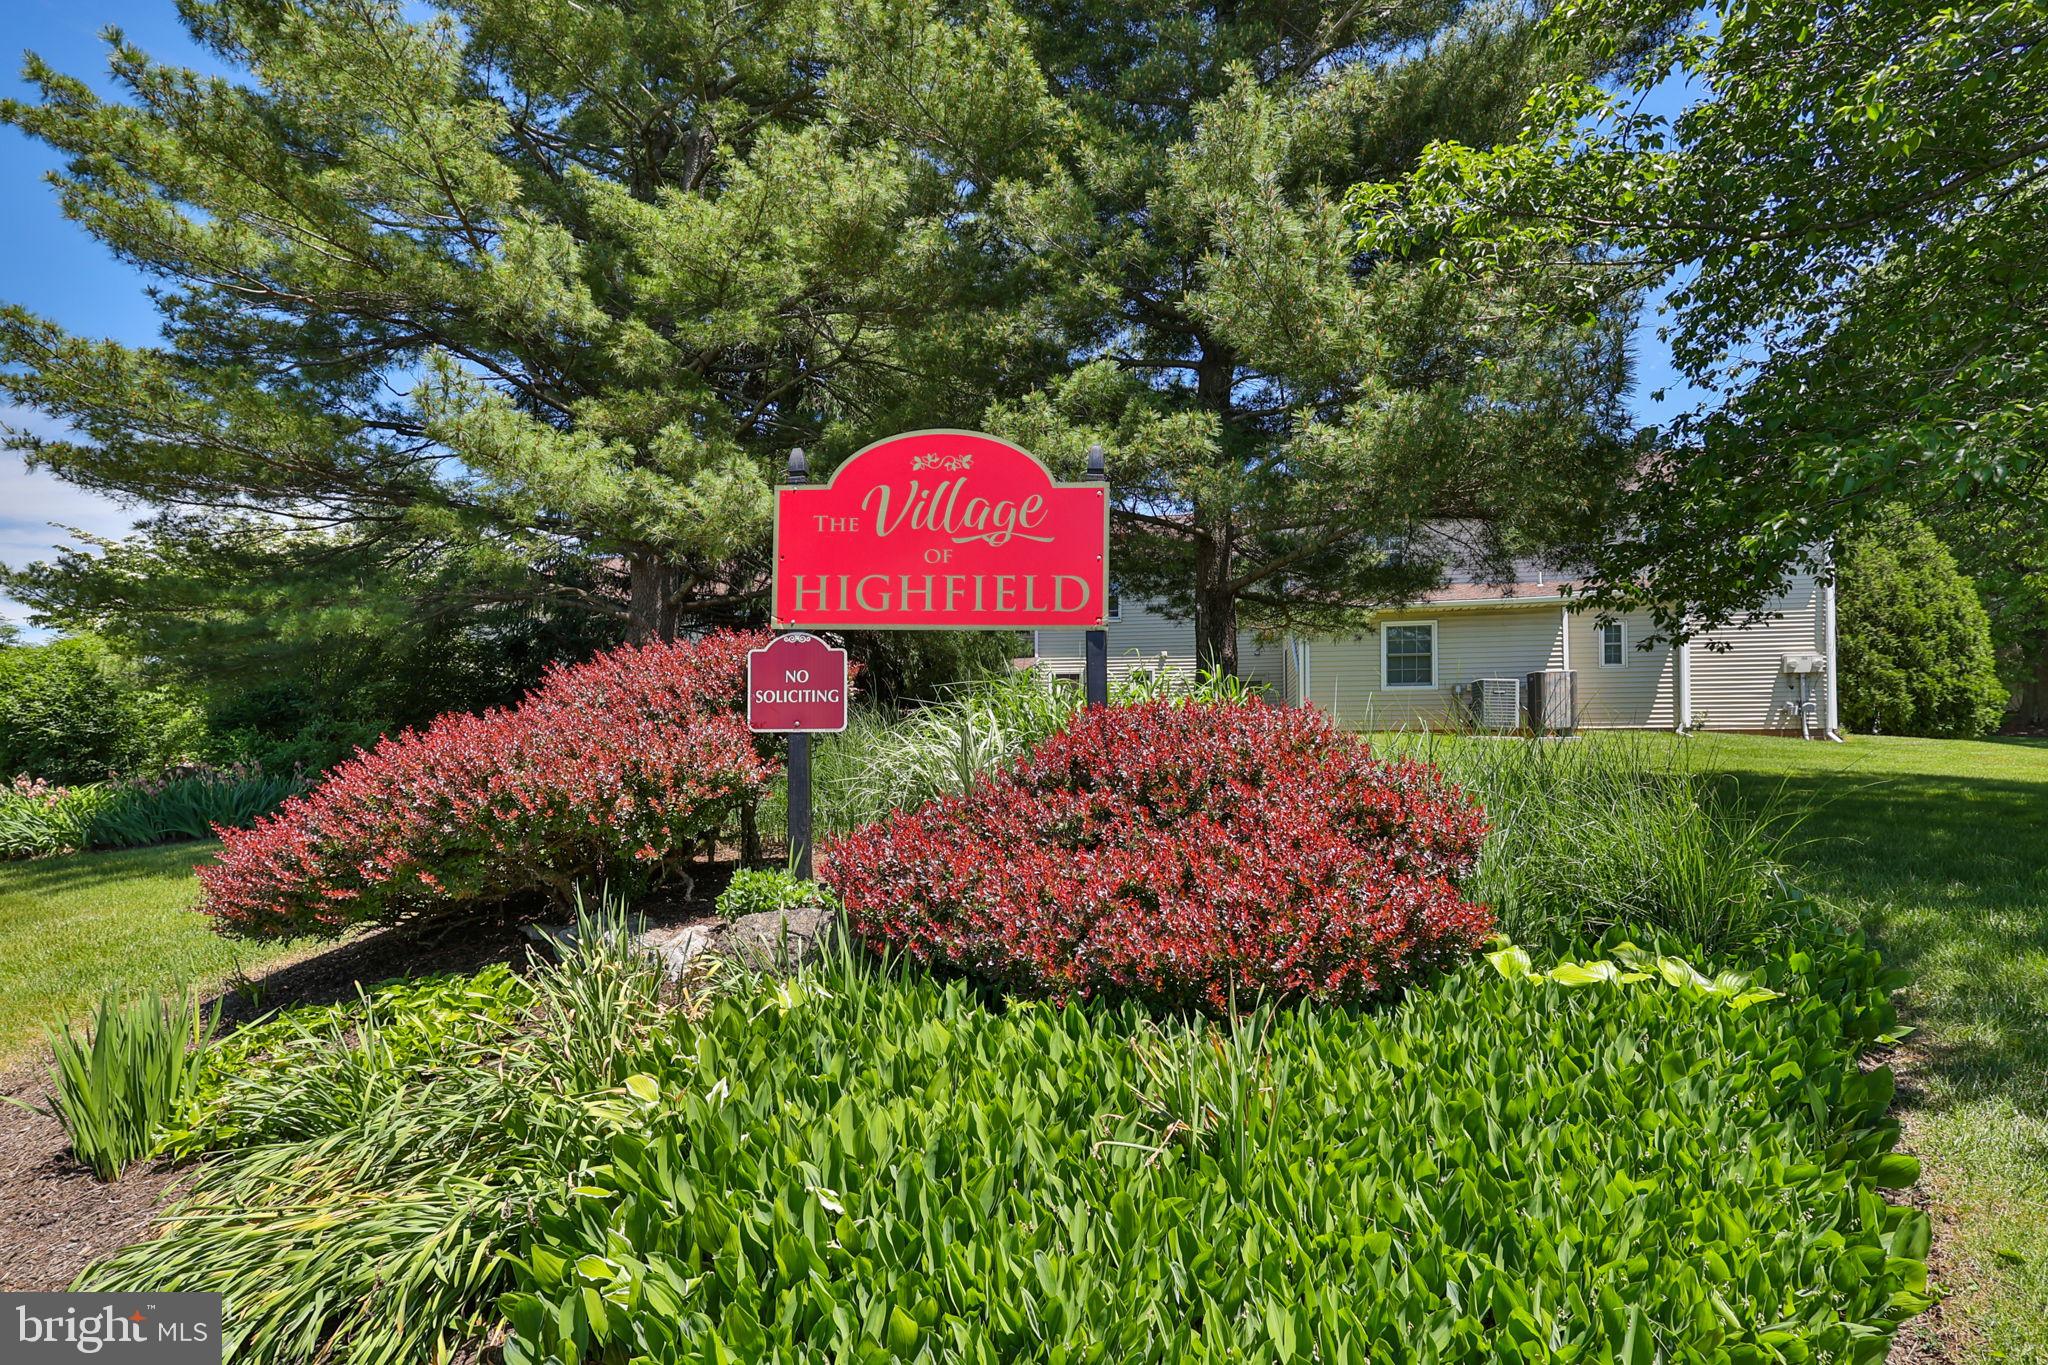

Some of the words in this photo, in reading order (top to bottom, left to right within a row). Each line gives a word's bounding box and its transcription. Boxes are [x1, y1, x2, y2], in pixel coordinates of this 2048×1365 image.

[813, 515, 859, 532] THE
[862, 477, 1055, 547] Village
[924, 548, 953, 564] OF
[792, 574, 1090, 613] HIGHFIELD
[785, 669, 810, 683] NO
[755, 689, 839, 704] SOLICITING
